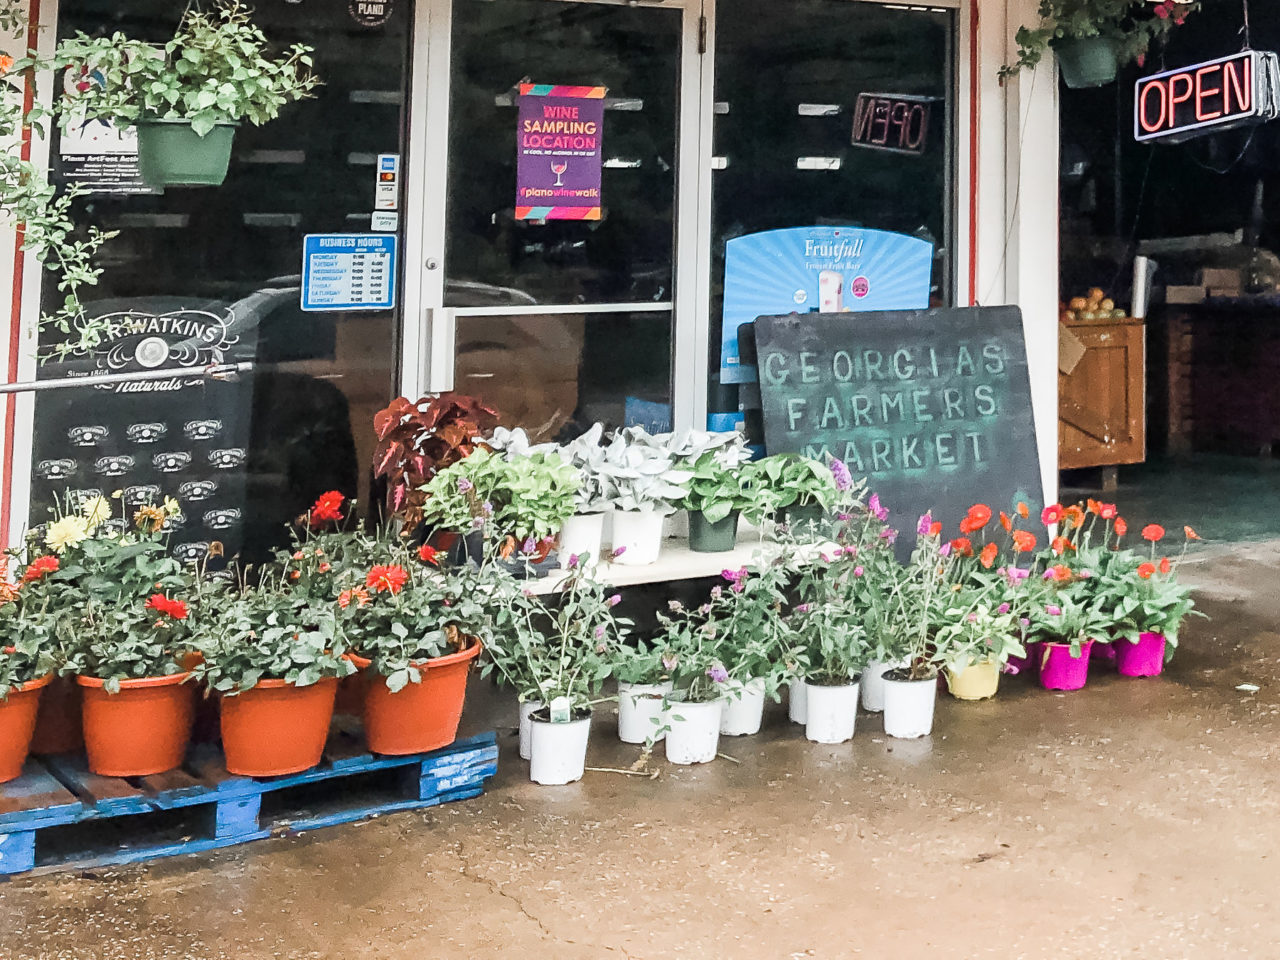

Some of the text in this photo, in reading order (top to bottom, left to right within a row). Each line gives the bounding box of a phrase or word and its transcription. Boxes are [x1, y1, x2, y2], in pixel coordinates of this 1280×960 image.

[358, 3, 384, 15] PLANO
[1139, 58, 1251, 132] OPEN
[543, 105, 579, 119] WINE
[523, 119, 597, 135] SAMPLING
[522, 134, 596, 149] LOCATION
[319, 237, 384, 247] BUSINESS HOURS
[805, 239, 864, 263] Fruitfull
[126, 316, 218, 342] WATKINS
[764, 344, 1006, 386] GEORGIAS
[786, 384, 997, 431] FARMERS
[802, 431, 983, 472] MARKET
